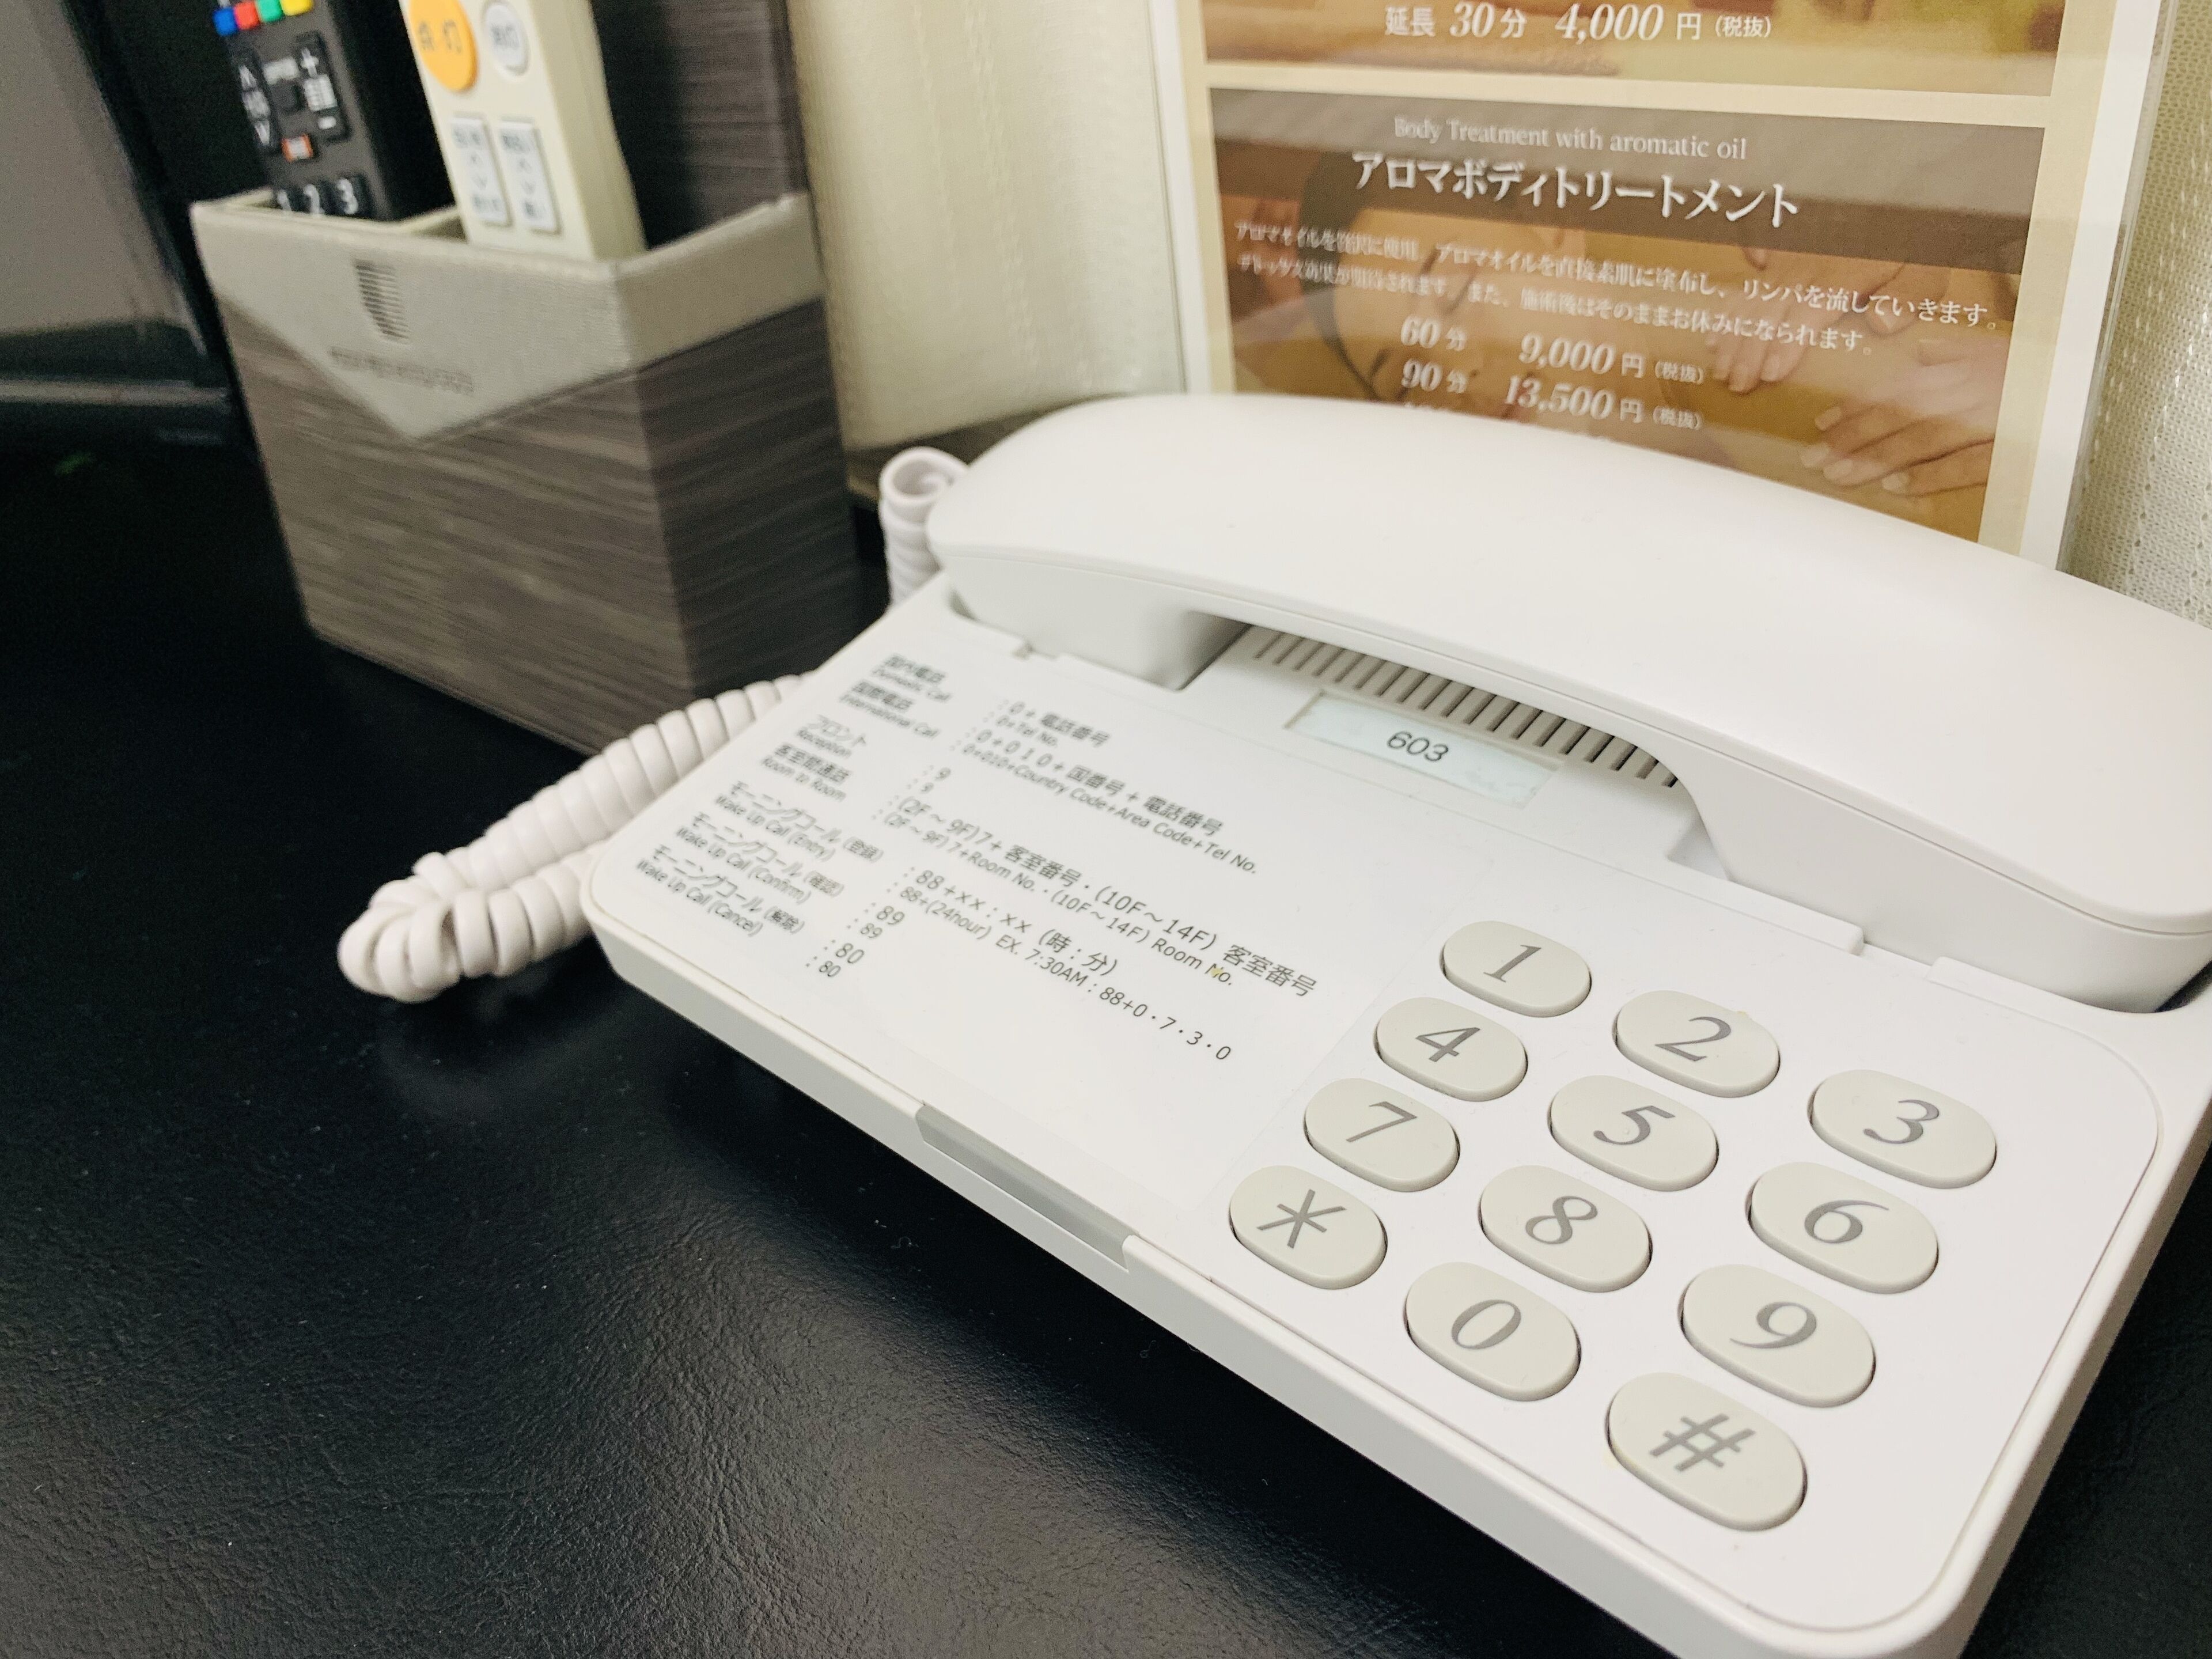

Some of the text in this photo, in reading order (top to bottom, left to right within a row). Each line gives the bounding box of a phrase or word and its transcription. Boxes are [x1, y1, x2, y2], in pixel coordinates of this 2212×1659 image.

[1394, 116, 1747, 160] Body Treatment with aromatic oil
[1353, 151, 1799, 229] アロマボディトリートメント
[1386, 730, 1449, 763] 603
[1230, 848, 1257, 874] No.
[1152, 938, 1202, 970] Room
[1205, 963, 1232, 985] No.
[1484, 945, 1940, 1145] 1 2 3
[1416, 1027, 1888, 1244] 4 5 6
[1346, 1101, 1817, 1349] 7 8 9
[1451, 1300, 1521, 1350] 0
